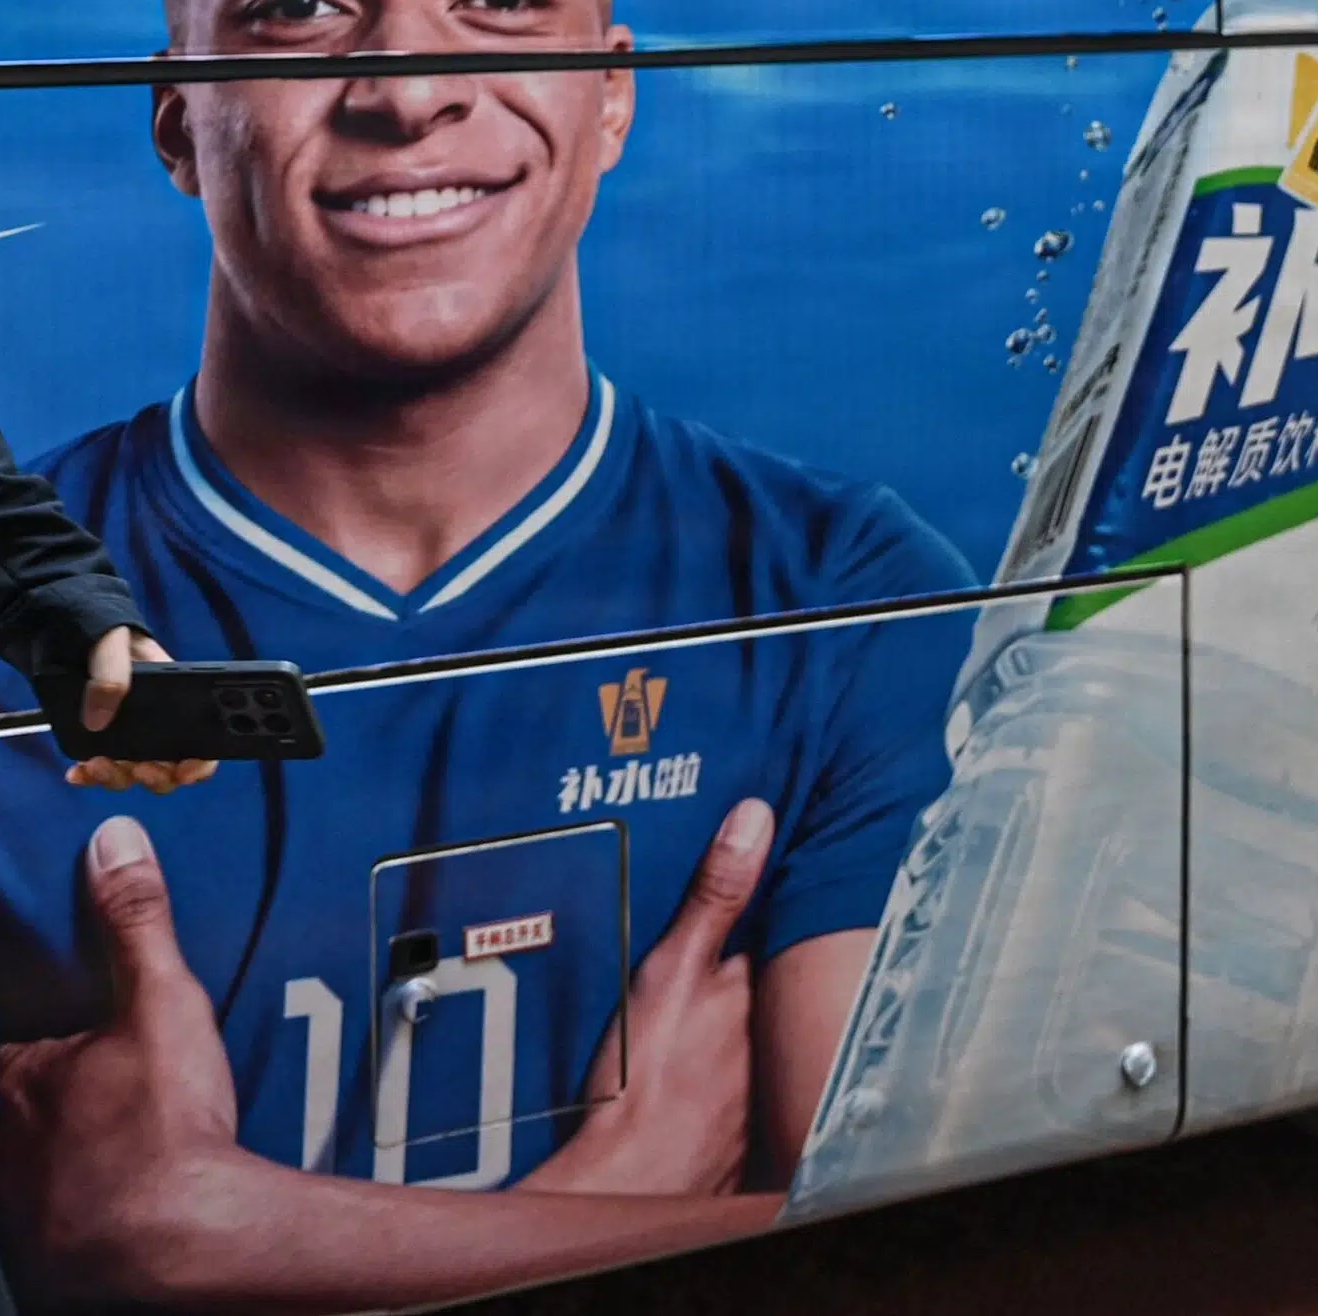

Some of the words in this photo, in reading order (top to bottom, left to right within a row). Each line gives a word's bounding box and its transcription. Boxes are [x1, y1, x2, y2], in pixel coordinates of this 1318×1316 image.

[558, 752, 701, 813] 补水啦
[284, 961, 517, 1191] 10
